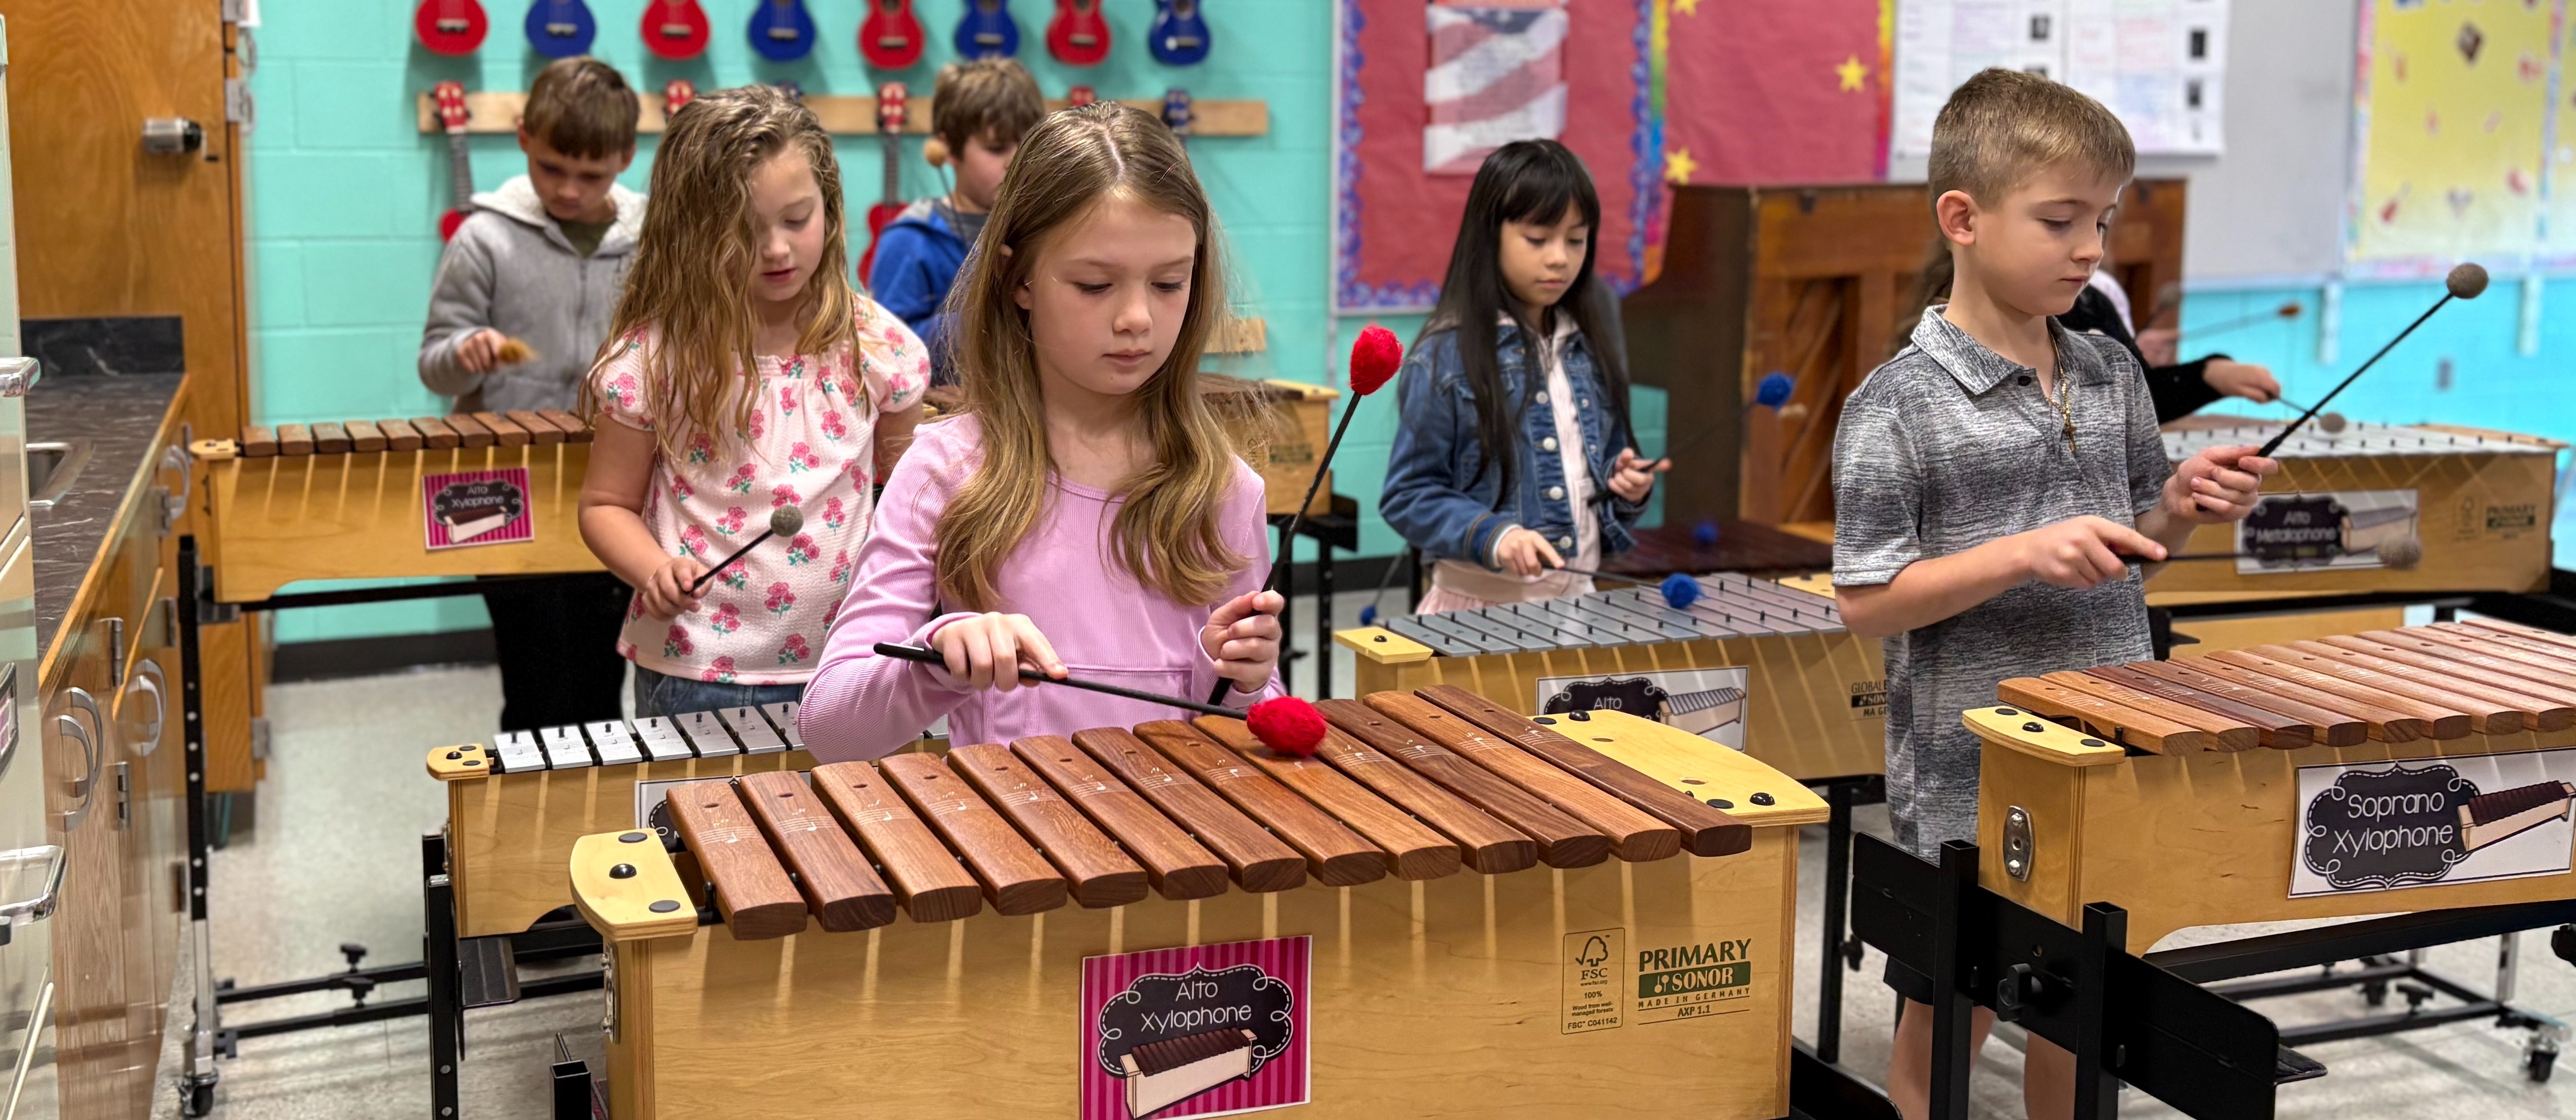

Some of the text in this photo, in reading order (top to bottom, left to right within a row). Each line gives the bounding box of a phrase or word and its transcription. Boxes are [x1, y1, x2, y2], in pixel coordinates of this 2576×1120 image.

[467, 485, 488, 495] Alto
[452, 496, 504, 509] Xylophone
[2284, 511, 2311, 525] Alto
[1851, 680, 1882, 694] GLOBAL
[1593, 696, 1622, 710] Alto
[2348, 792, 2445, 822] Soprano
[2333, 824, 2453, 858] Xylophone
[1639, 938, 1751, 972] PRIMARY
[1581, 967, 1608, 980] FSC
[1672, 967, 1733, 991] SONOR
[1175, 981, 1218, 1001] Alto
[1584, 991, 1603, 999] 100%
[1638, 987, 1750, 1008] MADE IN GERMANY
[1677, 1004, 1711, 1017] AXP 1.1
[1141, 1005, 1252, 1034] Xylophone
[1588, 1017, 1617, 1027] C041142
